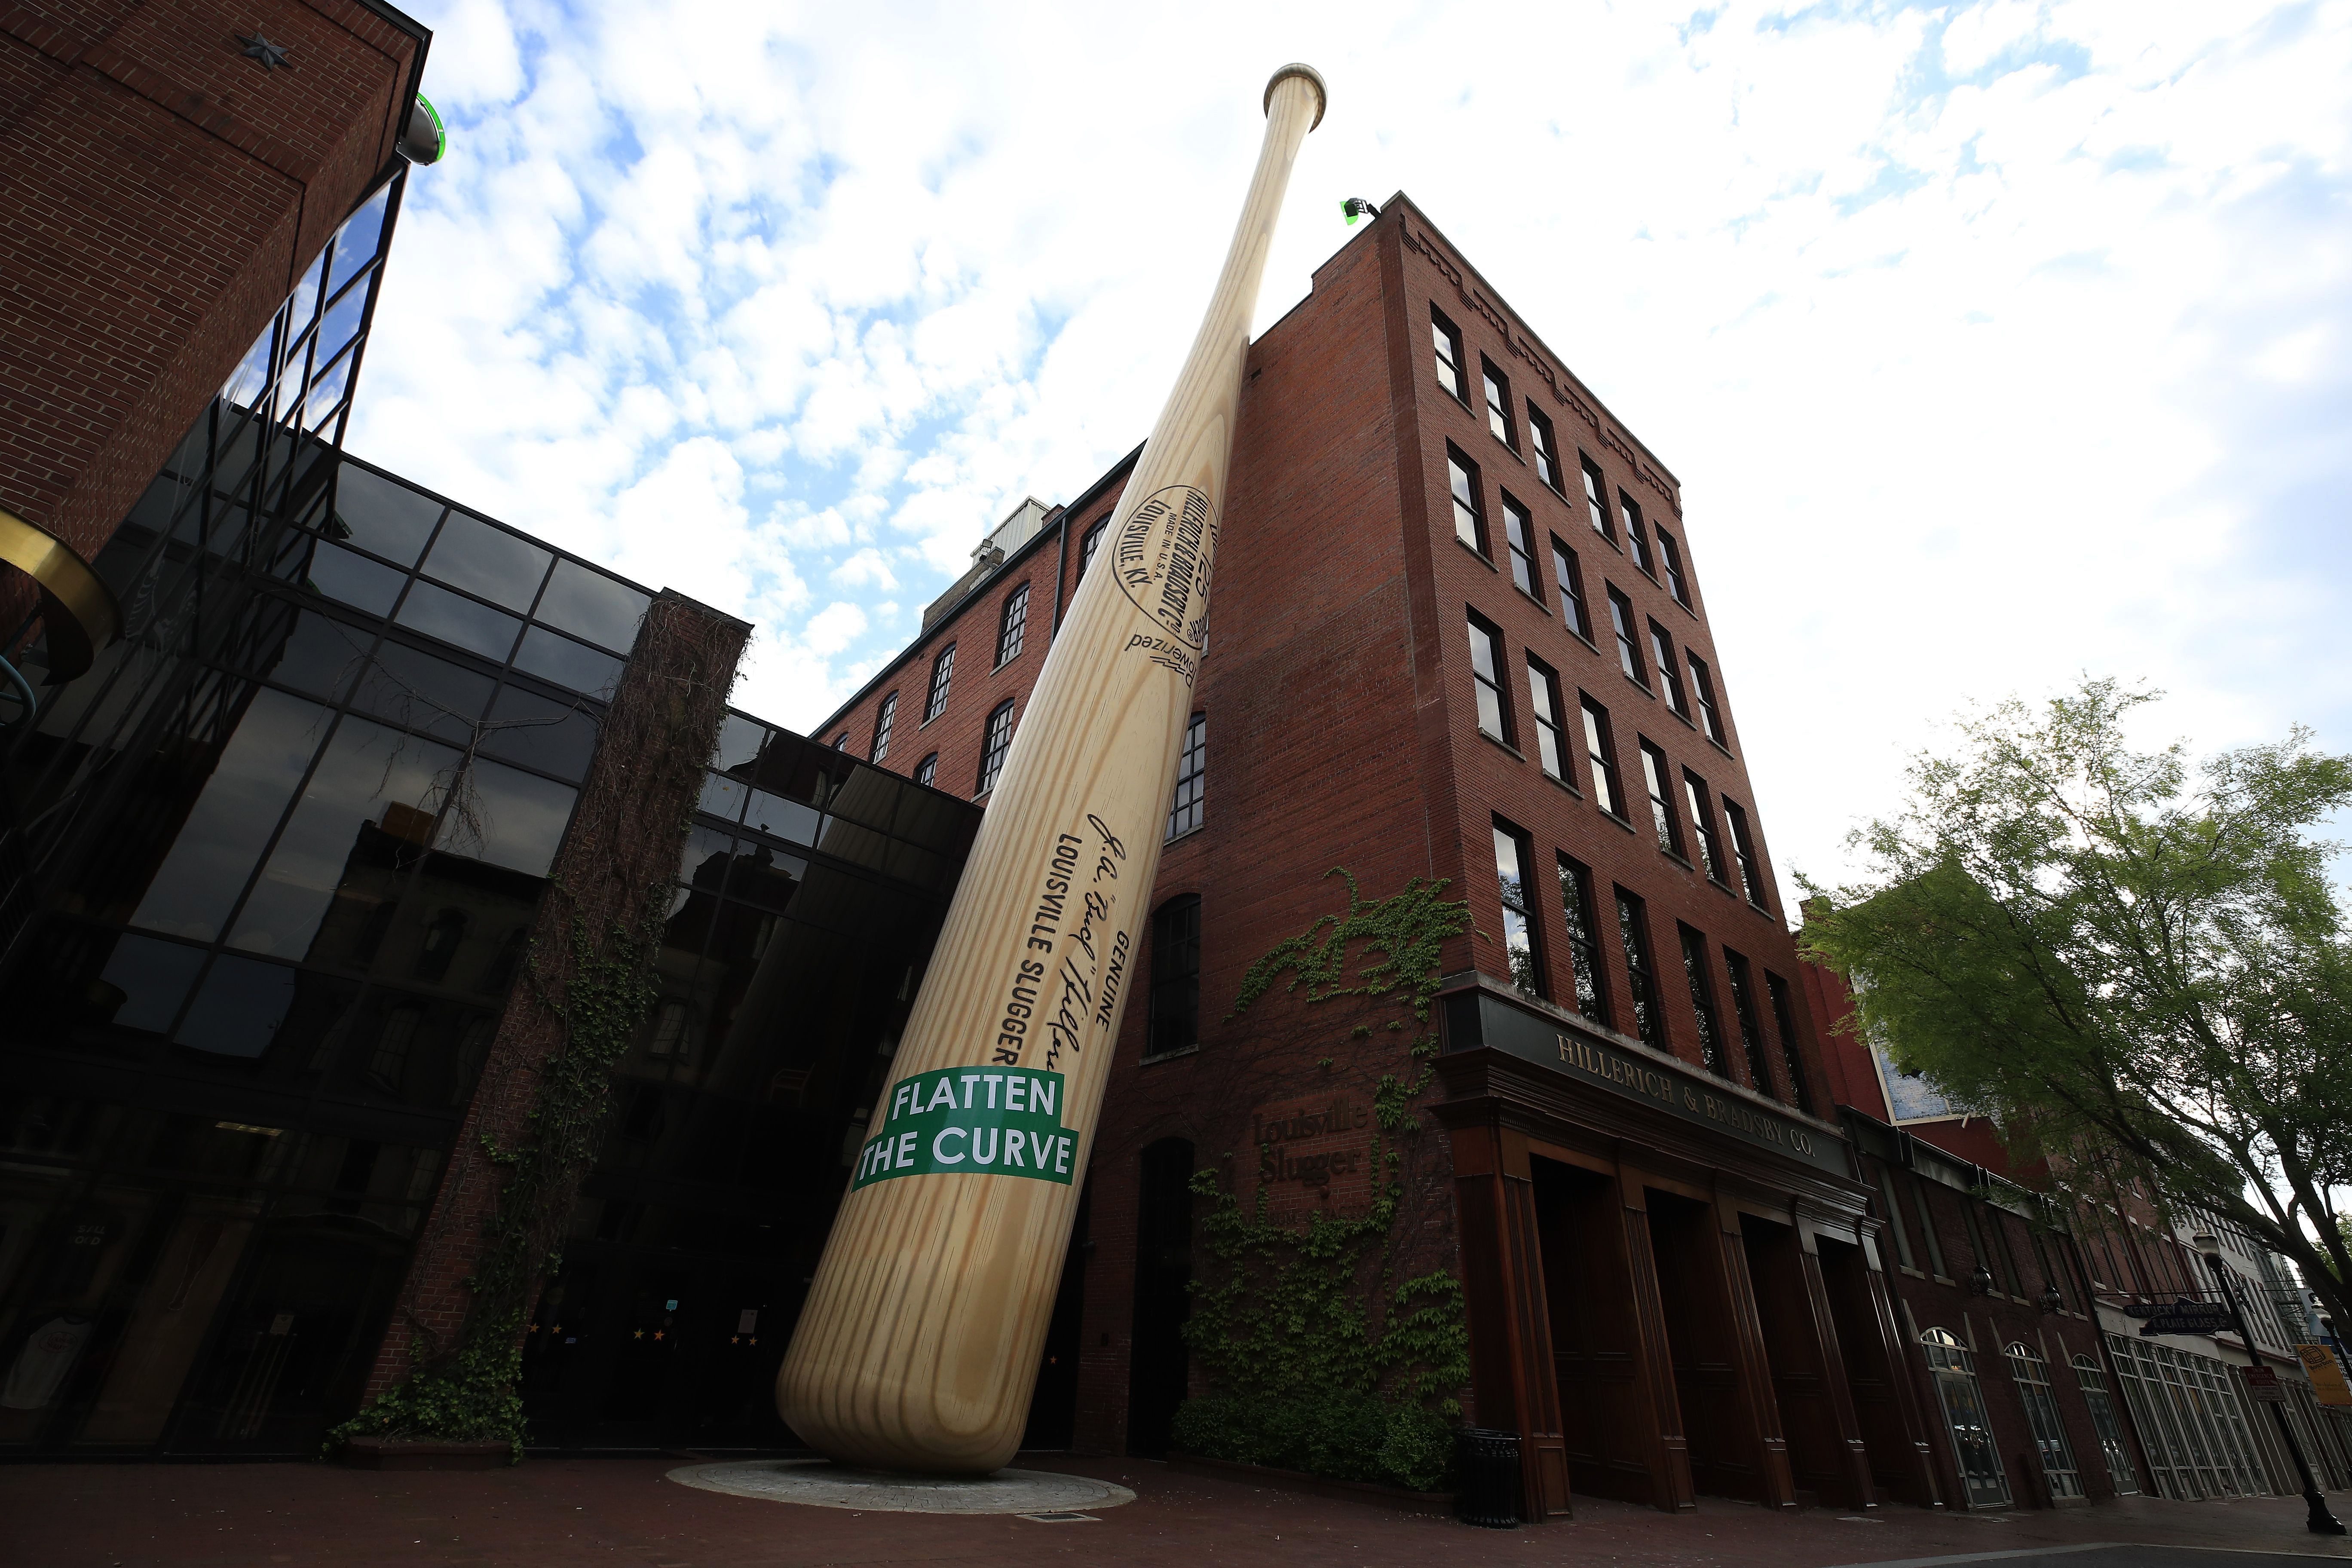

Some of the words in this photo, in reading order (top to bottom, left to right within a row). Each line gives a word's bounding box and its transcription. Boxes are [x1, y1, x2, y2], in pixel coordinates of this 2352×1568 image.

[1162, 539, 1171, 549] IN
[1164, 512, 1177, 536] MADE
[1176, 490, 1208, 553] HILLERICH
[1154, 553, 1168, 580] U.S.A.
[1174, 543, 1196, 561] &
[1124, 568, 1153, 588] KY.
[1161, 552, 1195, 620] BRADSBY
[1195, 551, 1212, 605] 125
[1124, 634, 1197, 689] Powerized
[1028, 833, 1082, 954] LOUISVILLE
[1096, 930, 1130, 1032] GENUINE
[992, 959, 1044, 1066] SLUGGER
[892, 1074, 1056, 1121] FLATTEN
[1556, 1033, 1675, 1105] HILLERICH
[1684, 1086, 1699, 1113] &
[1703, 1094, 1784, 1145] BRADSBY
[1789, 1129, 1816, 1158] CO.
[1252, 1096, 1368, 1145] Louisville
[859, 1130, 918, 1181] THE
[932, 1126, 1072, 1174] CURVE
[1259, 1147, 1362, 1187] Slugger
[2127, 1305, 2176, 1316] KENTUCKY
[2179, 1305, 2222, 1315] MIRROR
[2160, 1318, 2187, 1329] PLATE
[2187, 1317, 2217, 1328] GLASS
[2309, 1359, 2333, 1370] Bourbon
